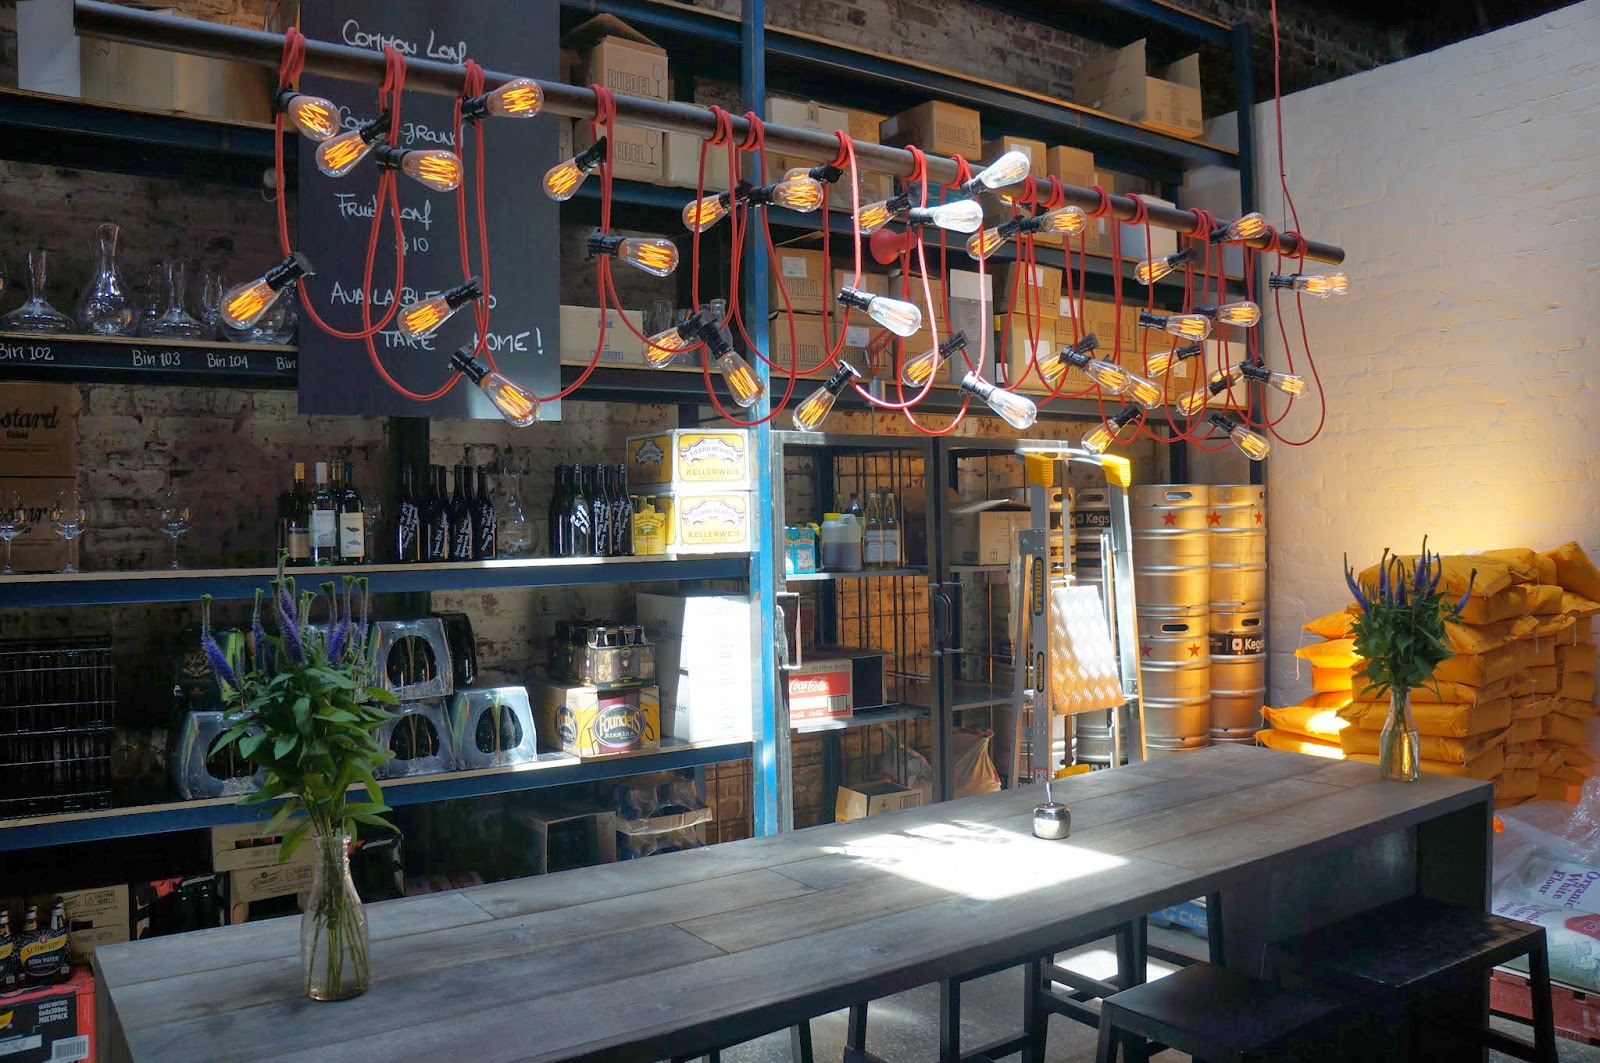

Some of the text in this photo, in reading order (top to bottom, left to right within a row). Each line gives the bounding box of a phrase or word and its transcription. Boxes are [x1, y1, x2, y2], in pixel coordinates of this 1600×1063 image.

[608, 68, 651, 96] RIEDEL
[936, 121, 969, 144] RIEDEL
[613, 141, 645, 163] EDEL
[29, 346, 54, 361] 102
[132, 349, 181, 368] Bin 103
[206, 353, 249, 369] Bin 104
[276, 356, 296, 371] Bin
[686, 468, 739, 477] KELLERWEIS
[688, 530, 740, 539] KELLERWEIS
[1034, 560, 1043, 613] GORILLA
[789, 676, 829, 695] Coca-Cola
[599, 711, 640, 737] Founders
[1538, 870, 1566, 894] Flour
[1552, 873, 1583, 899] White
[1564, 871, 1600, 908] Organic
[28, 957, 42, 965] SODA
[38, 1012, 68, 1023] MULTIPACK
